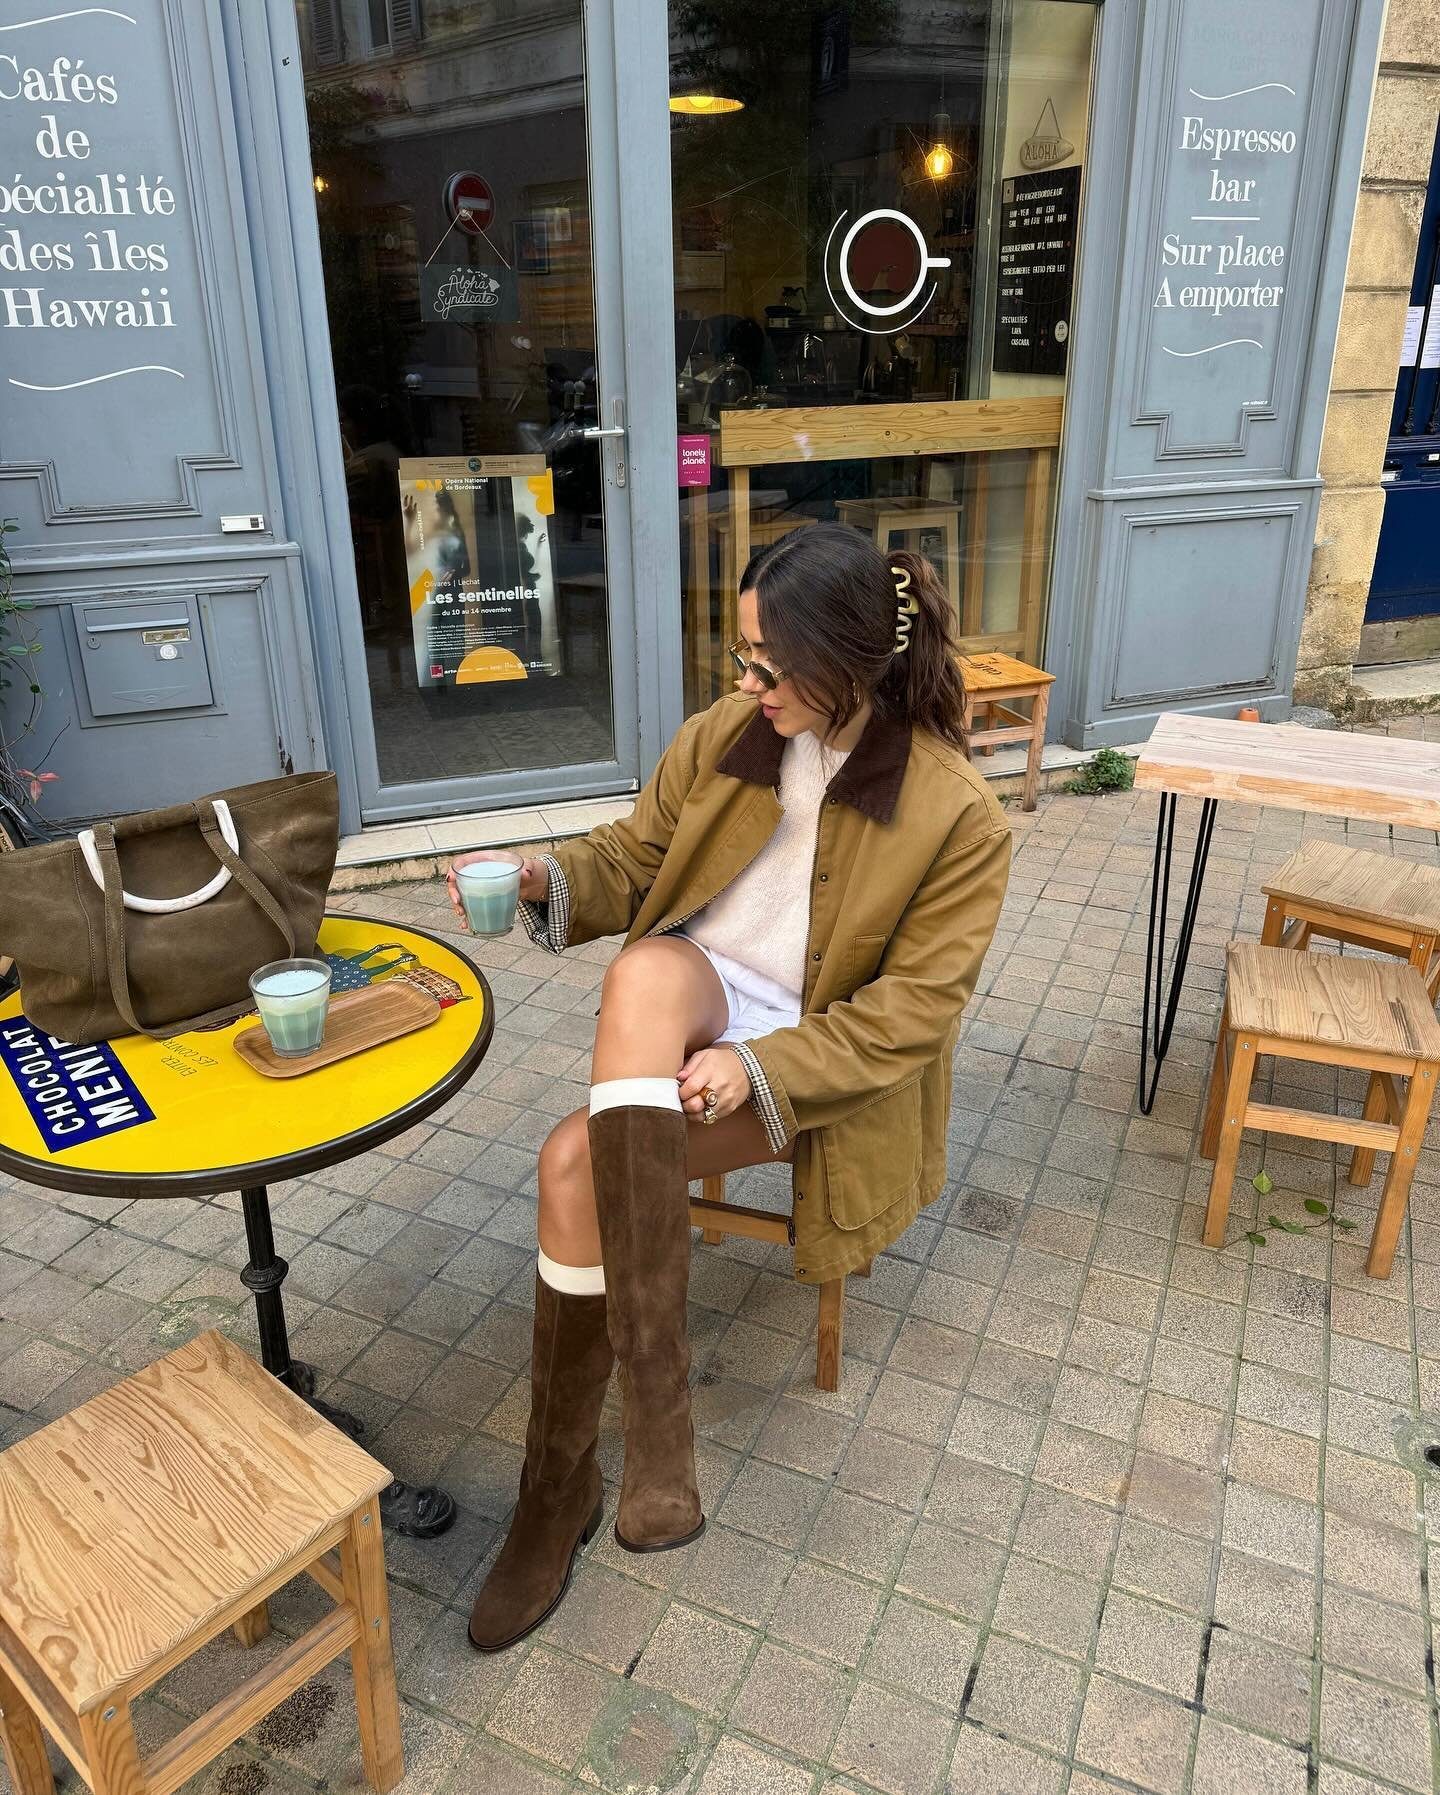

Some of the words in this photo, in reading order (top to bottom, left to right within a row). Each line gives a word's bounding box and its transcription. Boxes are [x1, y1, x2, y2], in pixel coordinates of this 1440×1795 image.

[0, 54, 118, 104] Cafés
[35, 115, 90, 160] de
[1025, 144, 1058, 161] ALOHA
[1178, 116, 1296, 161] Espresso
[1207, 169, 1256, 202] bar
[0, 229, 74, 272] des
[84, 230, 169, 272] îles
[1161, 233, 1212, 266] Sur
[1215, 235, 1285, 275] place
[443, 273, 489, 294] Aloha
[1153, 276, 1175, 308] A
[1179, 279, 1284, 316] emporter
[2, 287, 177, 328] Hawaii
[433, 288, 499, 320] Syndicate
[682, 448, 706, 458] lonely
[682, 457, 706, 466] planet
[424, 590, 453, 605] Les
[458, 585, 541, 603] sentinelles
[2, 1027, 86, 1135] CHOCOLAT
